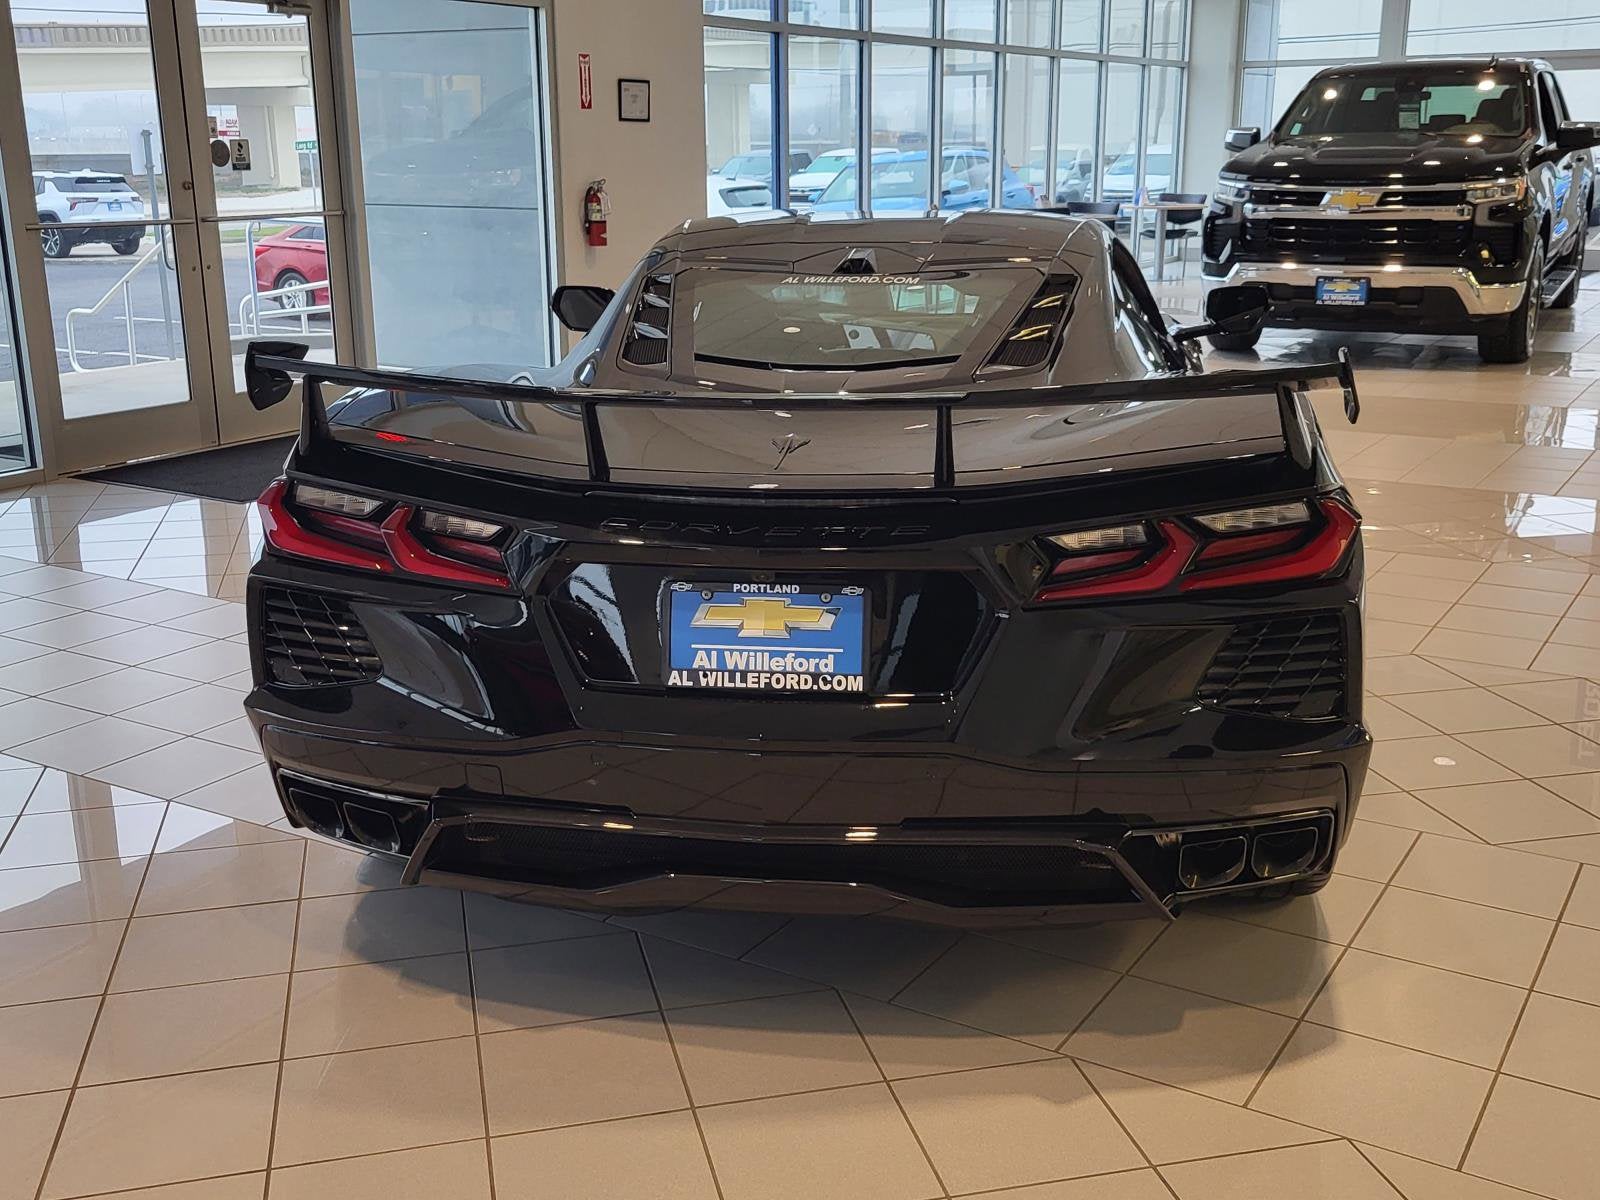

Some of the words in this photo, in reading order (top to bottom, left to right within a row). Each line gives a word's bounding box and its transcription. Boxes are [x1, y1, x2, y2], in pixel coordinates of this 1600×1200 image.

[781, 276, 800, 284] AL
[803, 276, 921, 285] WILLEFORD.COM
[599, 517, 932, 539] CORVETTE
[733, 583, 800, 594] PORTLAND
[692, 650, 717, 670] Al
[724, 651, 834, 673] Willeford
[668, 670, 694, 687] AL
[699, 671, 863, 691] WILLEFORD.COM
